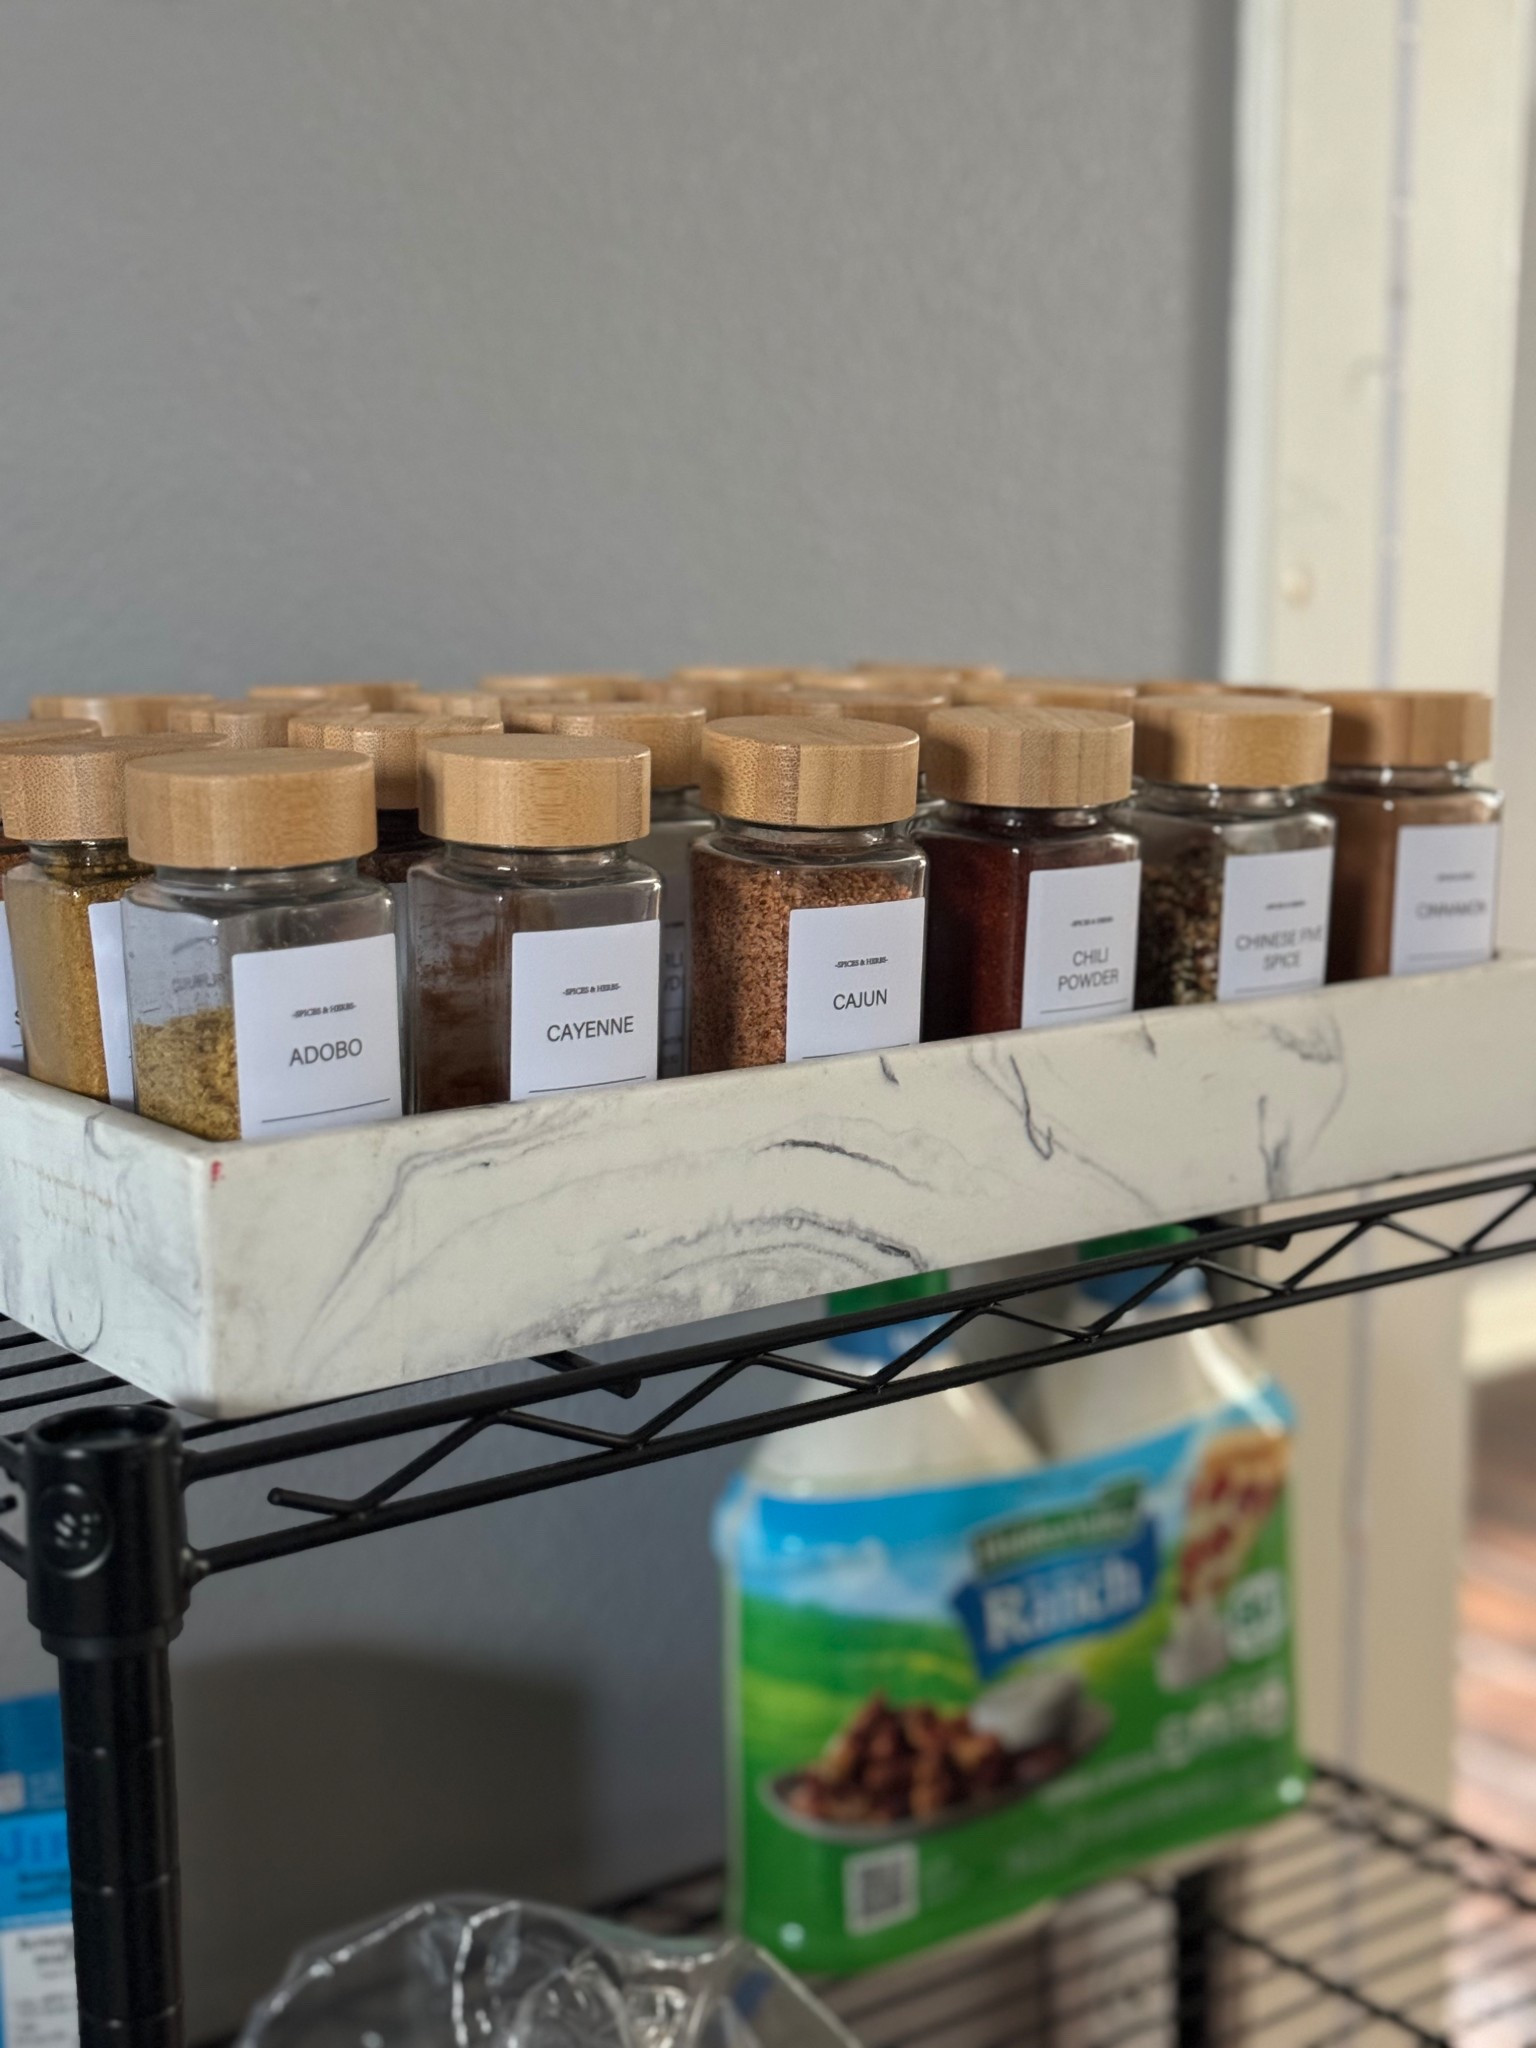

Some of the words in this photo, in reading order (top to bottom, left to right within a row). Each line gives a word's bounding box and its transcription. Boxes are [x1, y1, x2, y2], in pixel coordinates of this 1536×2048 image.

[1235, 928, 1297, 952] CHINESE
[1072, 947, 1109, 967] CHILI
[1057, 967, 1119, 992] POWDER
[833, 988, 888, 1011] CAJUN
[546, 1015, 634, 1042] CAYENNE
[289, 1038, 363, 1067] ADOBO
